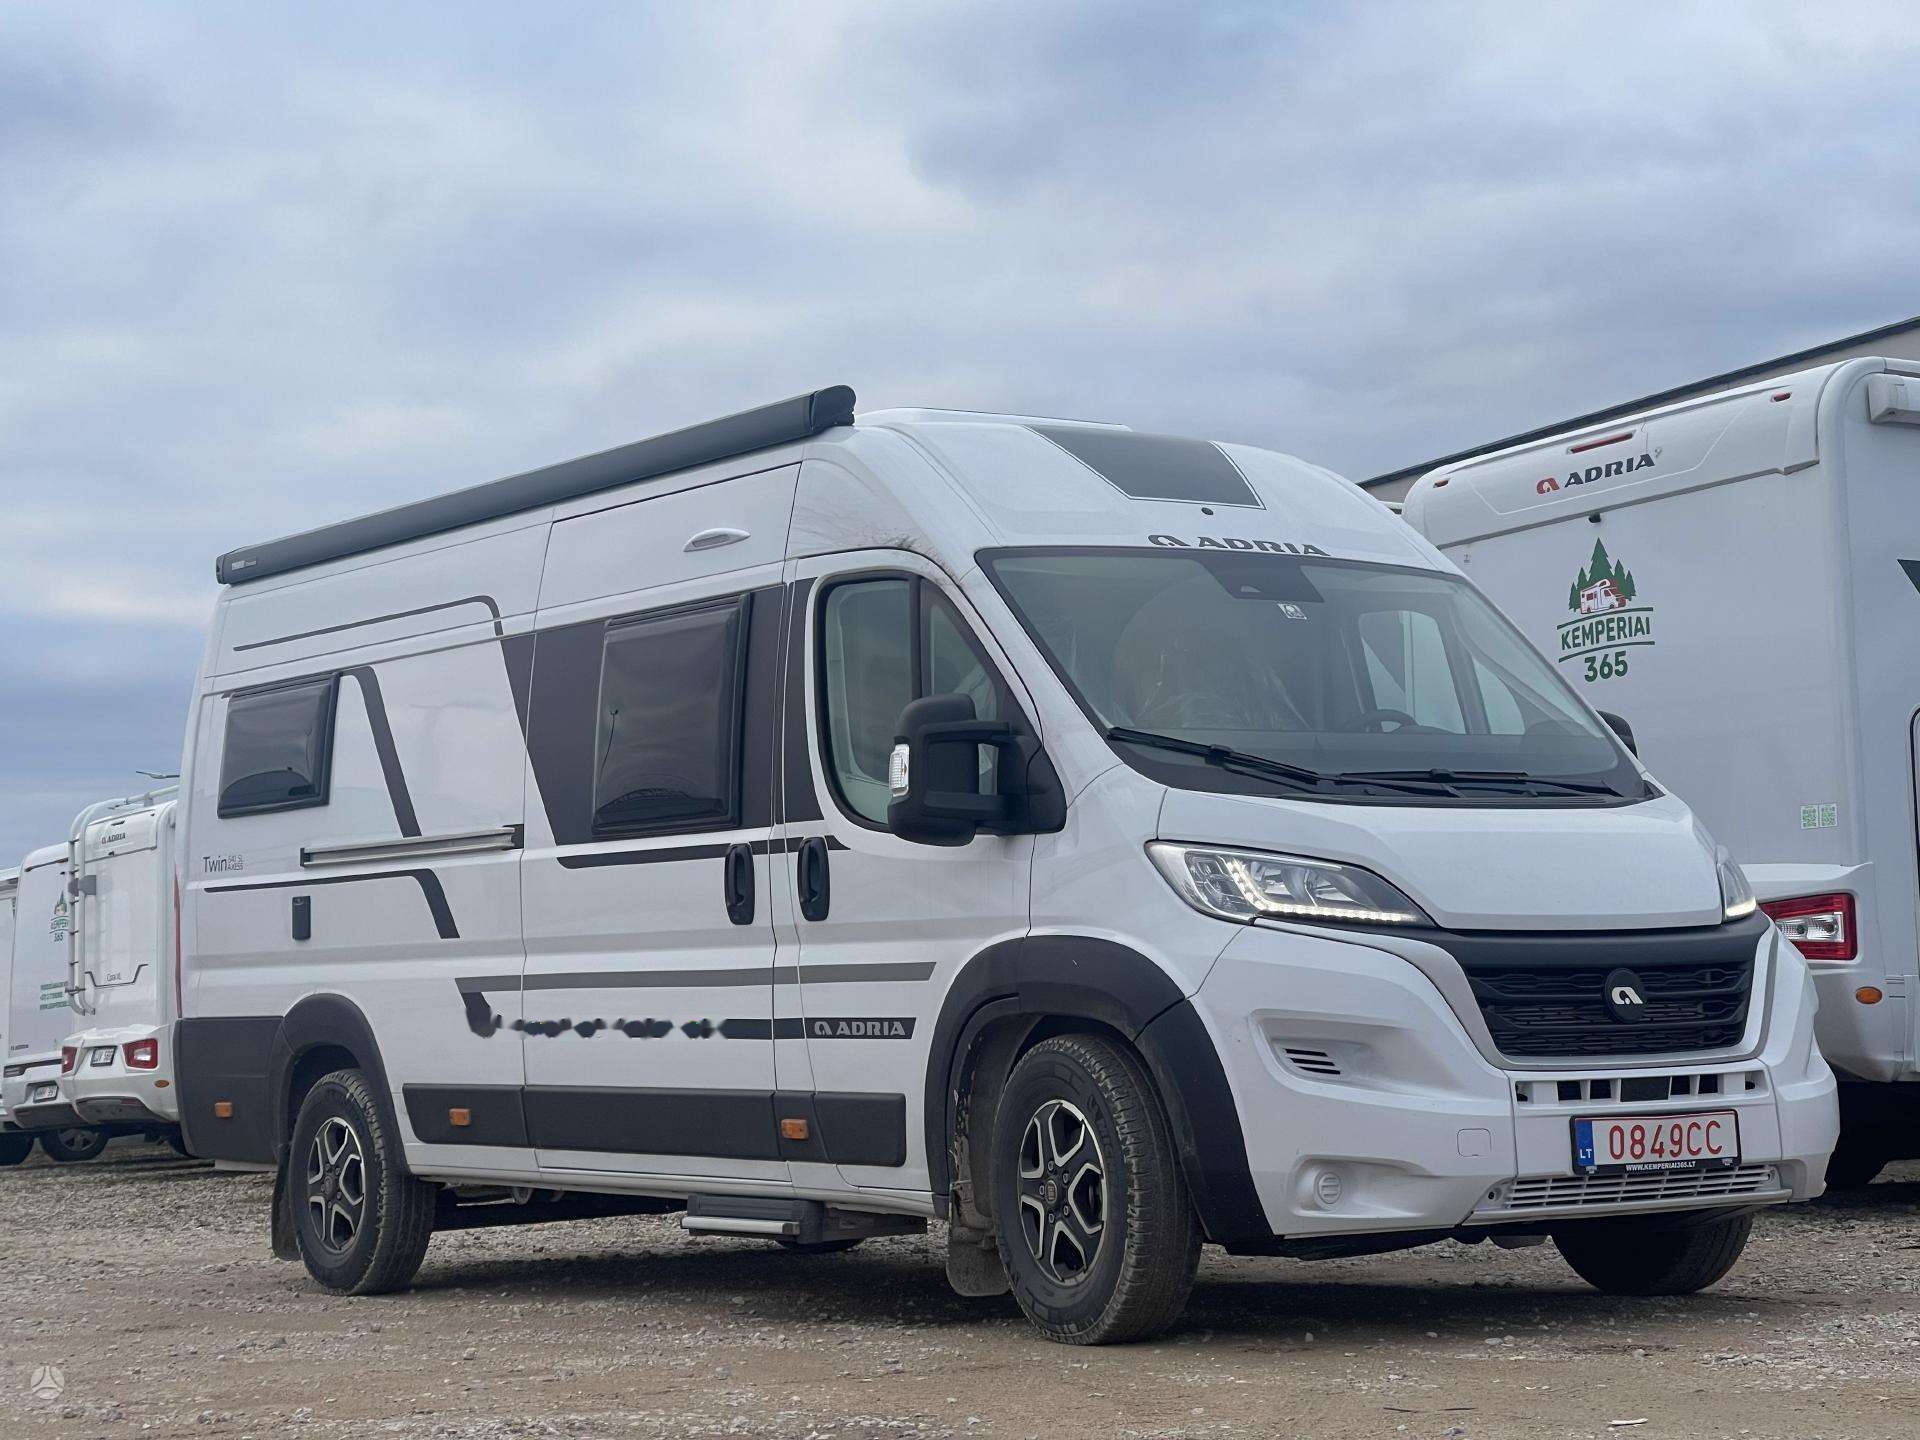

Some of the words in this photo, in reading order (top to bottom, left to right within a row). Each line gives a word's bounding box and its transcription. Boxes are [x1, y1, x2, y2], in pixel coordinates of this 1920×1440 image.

[1564, 453, 1655, 488] ADRIA
[1197, 536, 1332, 556] ADRIA
[1560, 616, 1652, 651] KEMPERIAI
[1583, 651, 1628, 683] 365
[203, 855, 228, 873] Twin
[836, 1021, 906, 1036] ADRIA
[1580, 1148, 1592, 1159] LT
[1608, 1120, 1723, 1160] 0849CC
